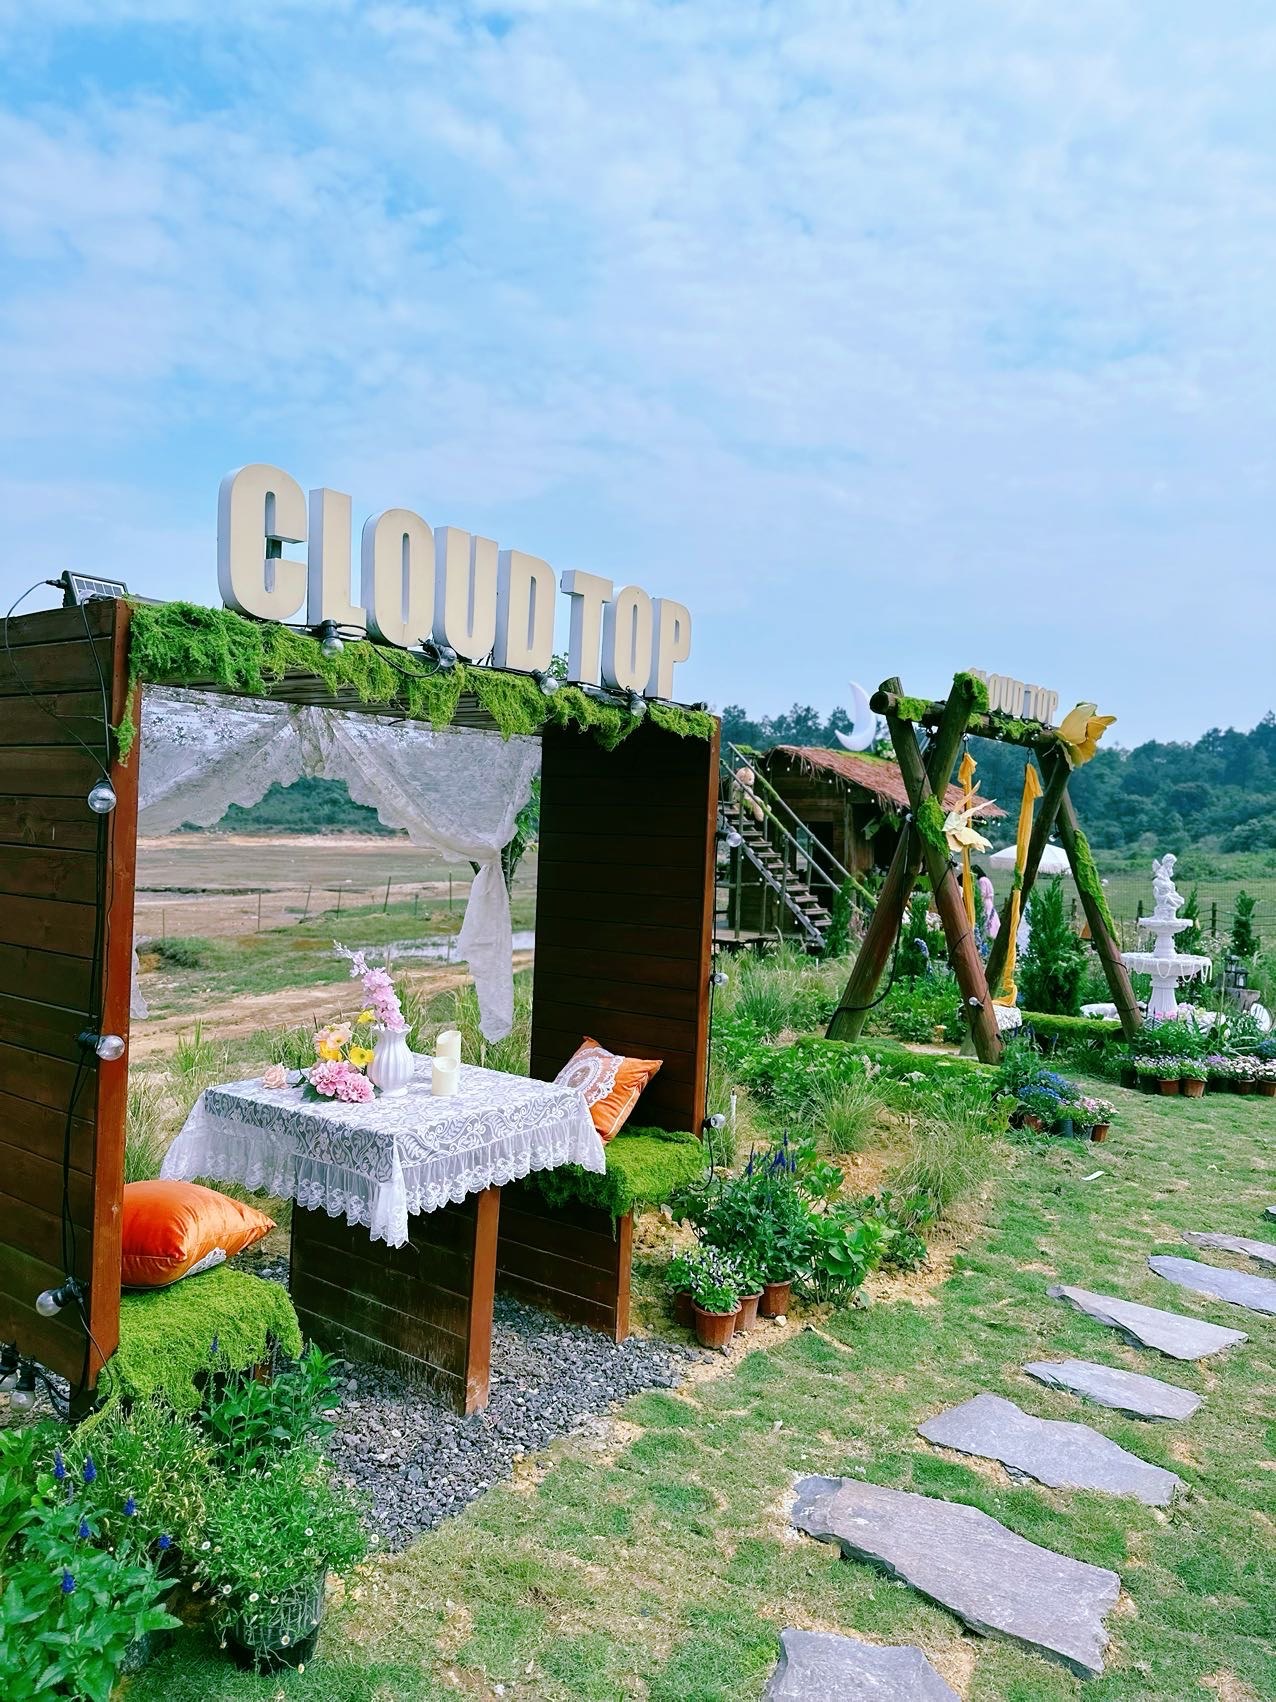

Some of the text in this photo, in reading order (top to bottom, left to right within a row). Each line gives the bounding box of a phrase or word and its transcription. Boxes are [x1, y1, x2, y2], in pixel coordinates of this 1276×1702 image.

[217, 464, 692, 699] CLOUD TOP
[968, 668, 1058, 725] OUD TOP
